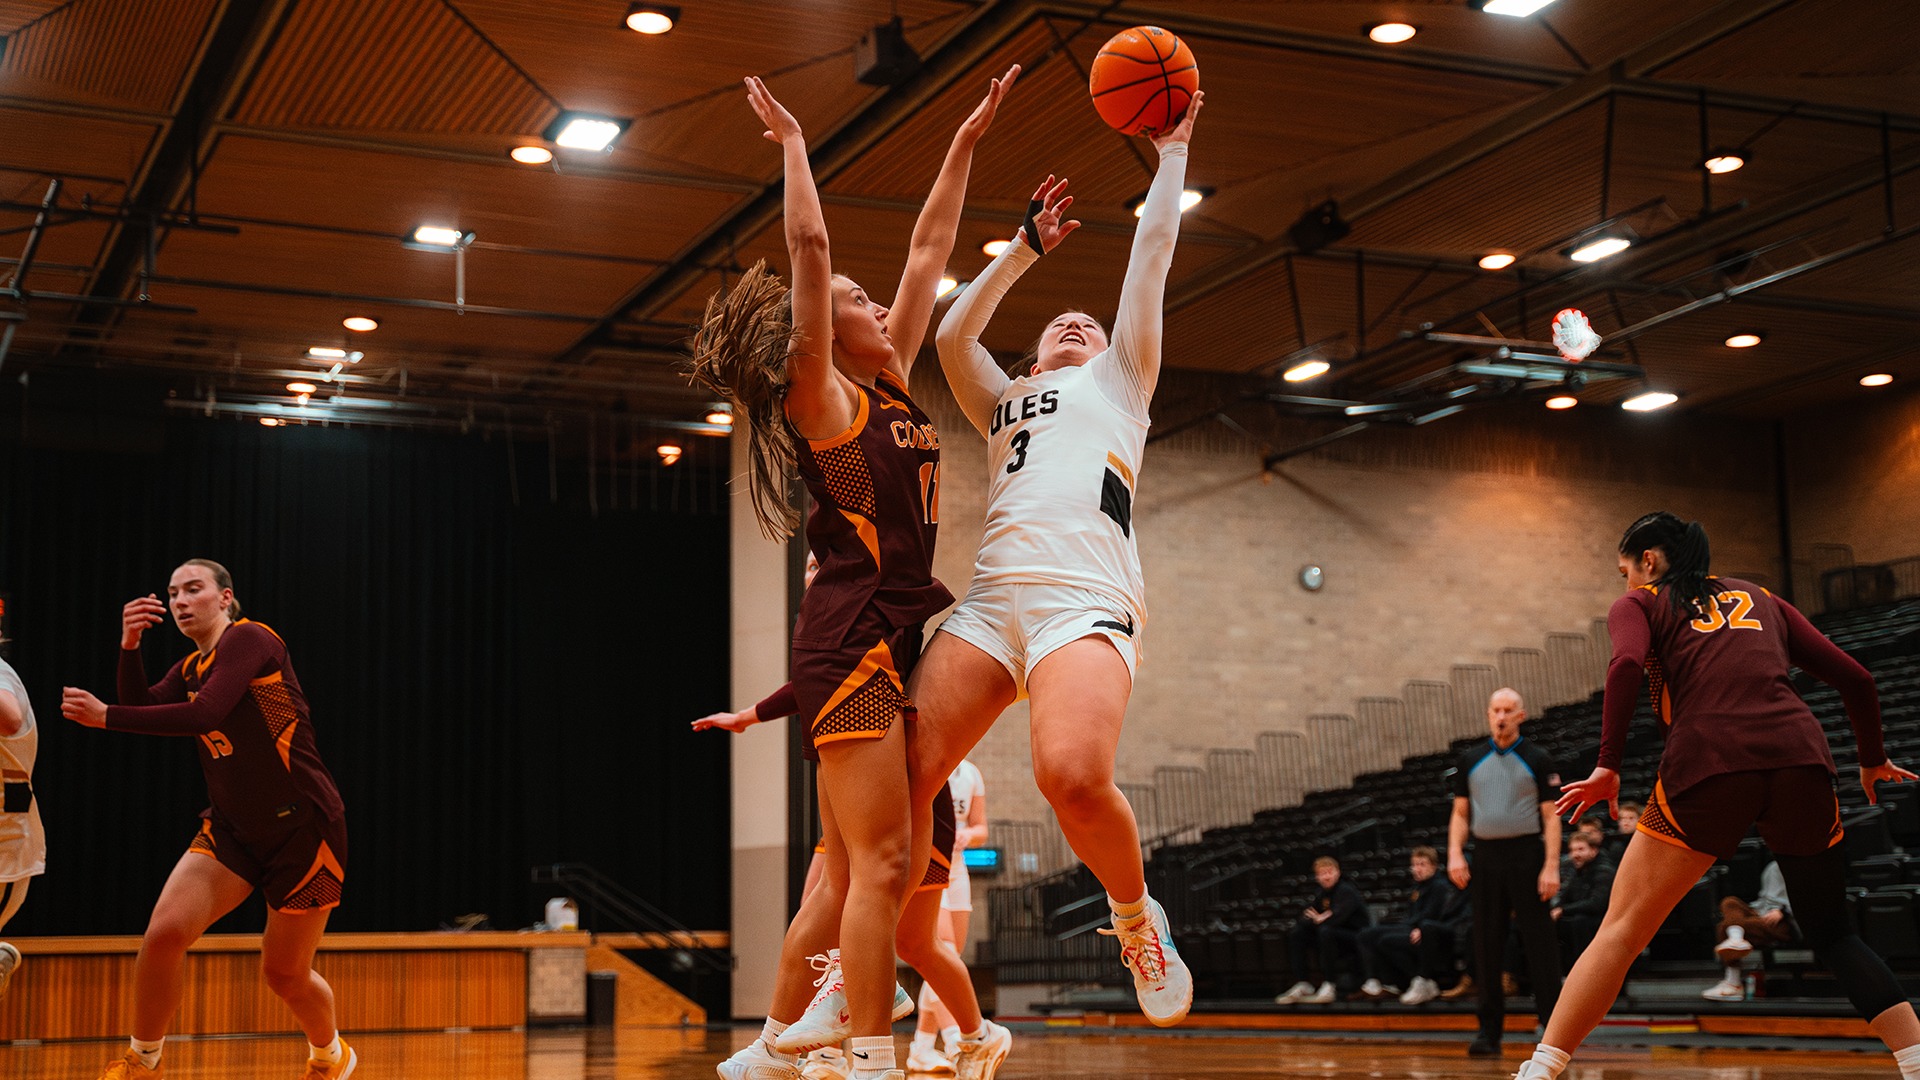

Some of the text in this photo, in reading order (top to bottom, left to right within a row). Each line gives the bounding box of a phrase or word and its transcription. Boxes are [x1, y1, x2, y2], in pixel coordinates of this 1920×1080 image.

[990, 389, 1059, 437] OLES
[1006, 429, 1031, 474] 3
[1690, 590, 1764, 633] 32
